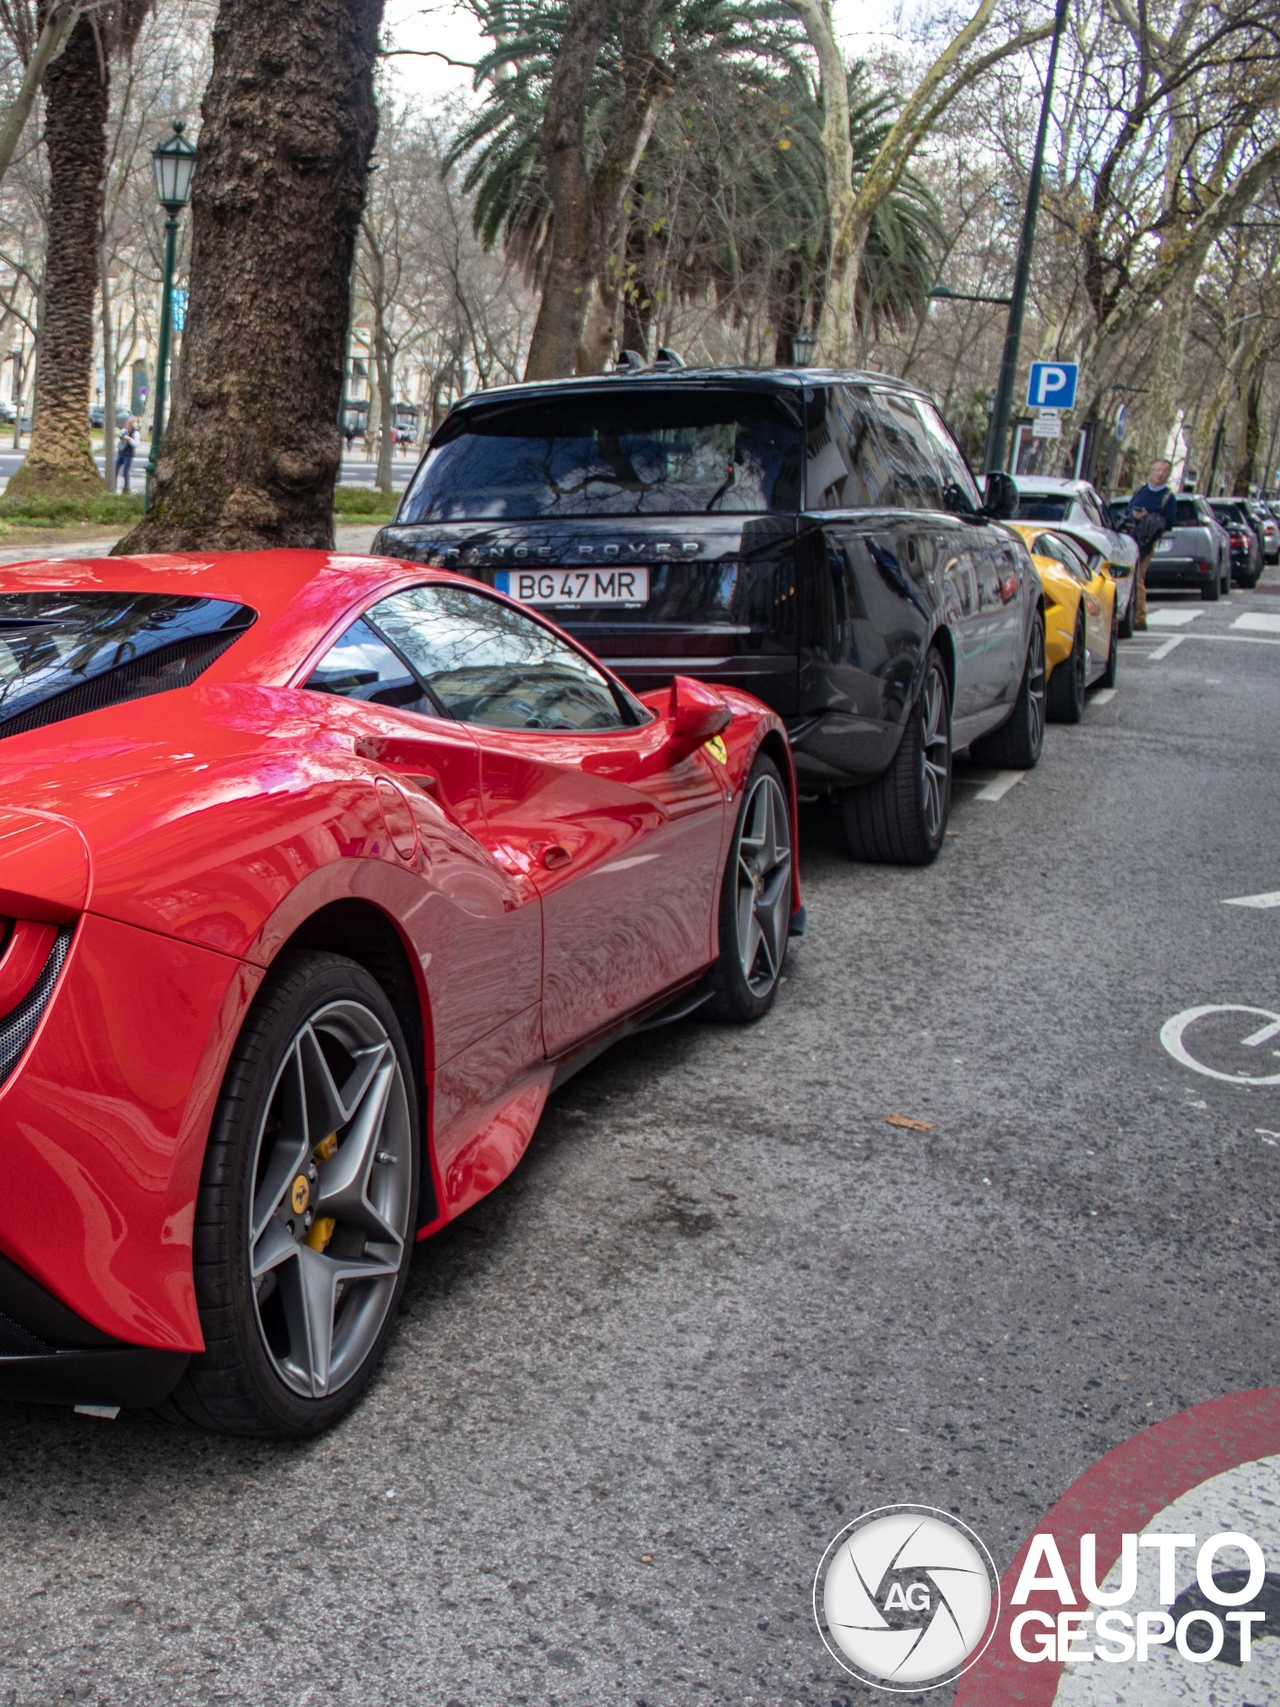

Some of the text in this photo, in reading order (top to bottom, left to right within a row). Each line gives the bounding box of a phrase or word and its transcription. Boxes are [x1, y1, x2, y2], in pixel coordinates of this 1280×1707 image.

[1038, 367, 1066, 403] P
[446, 543, 700, 559] RANGE ROVER
